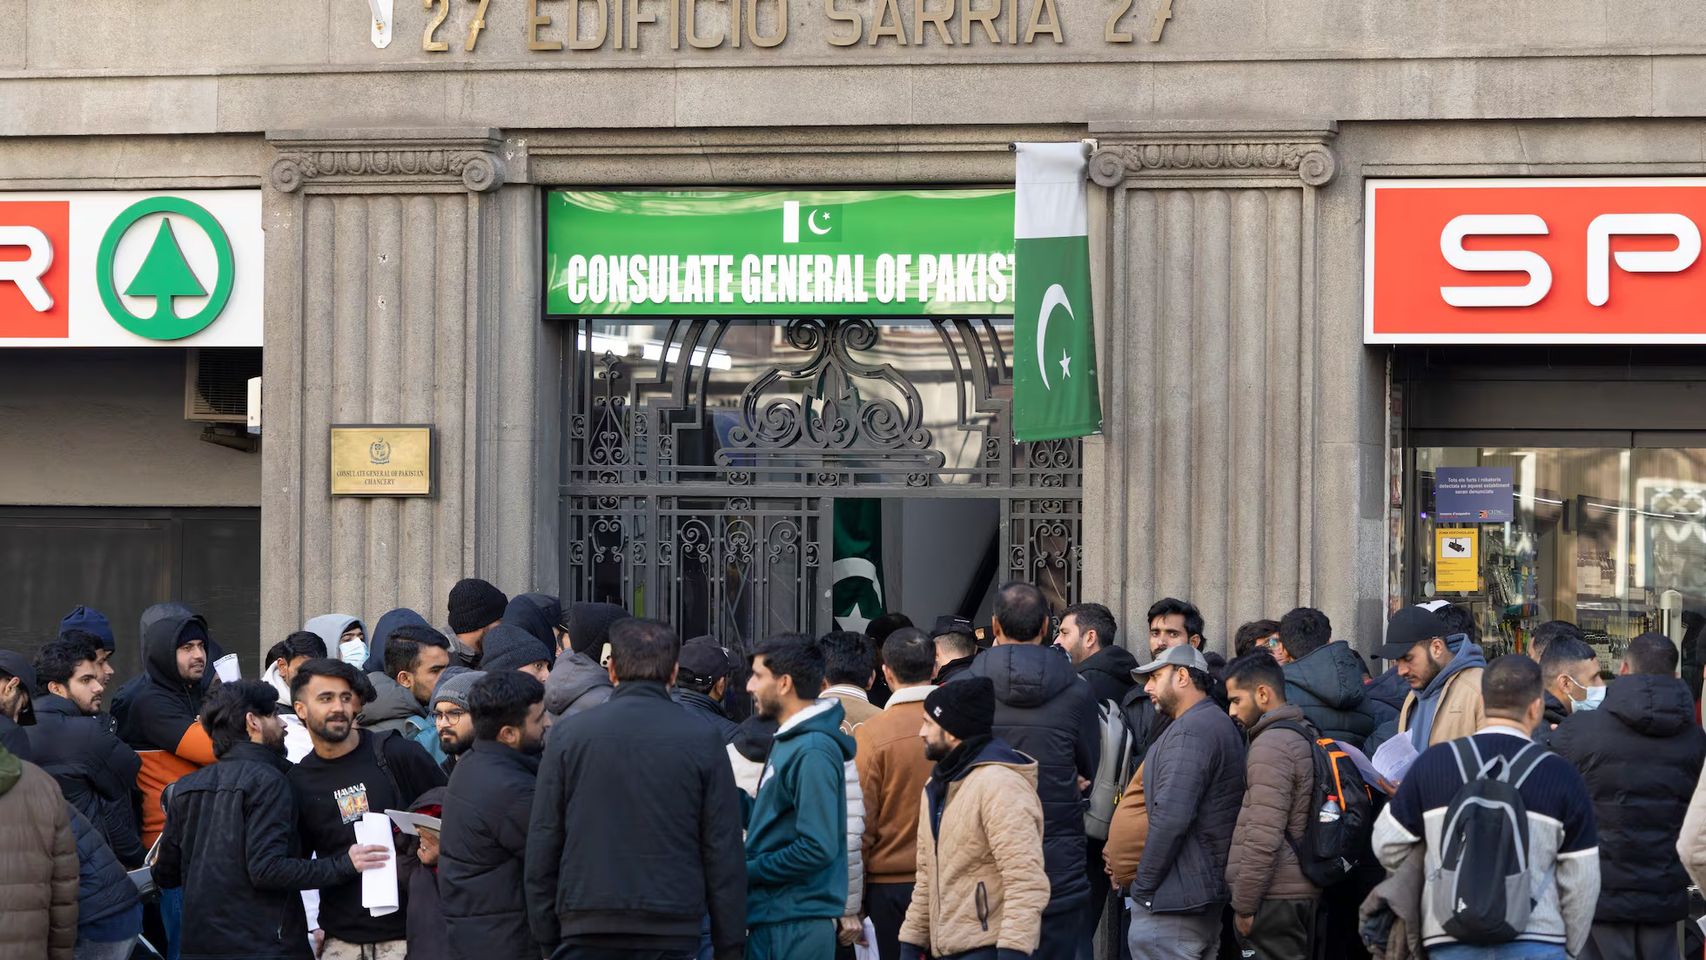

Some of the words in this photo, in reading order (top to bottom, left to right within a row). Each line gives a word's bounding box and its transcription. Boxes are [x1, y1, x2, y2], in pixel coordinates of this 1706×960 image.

[422, 0, 486, 50] 27
[528, 0, 788, 50] EDIFICIO
[1105, 0, 1173, 42] 27
[567, 254, 734, 304] CONSULATE
[741, 254, 869, 303] GENERAL
[875, 253, 912, 303] OF
[1440, 213, 1702, 307] SP
[333, 783, 366, 799] HAVANA
